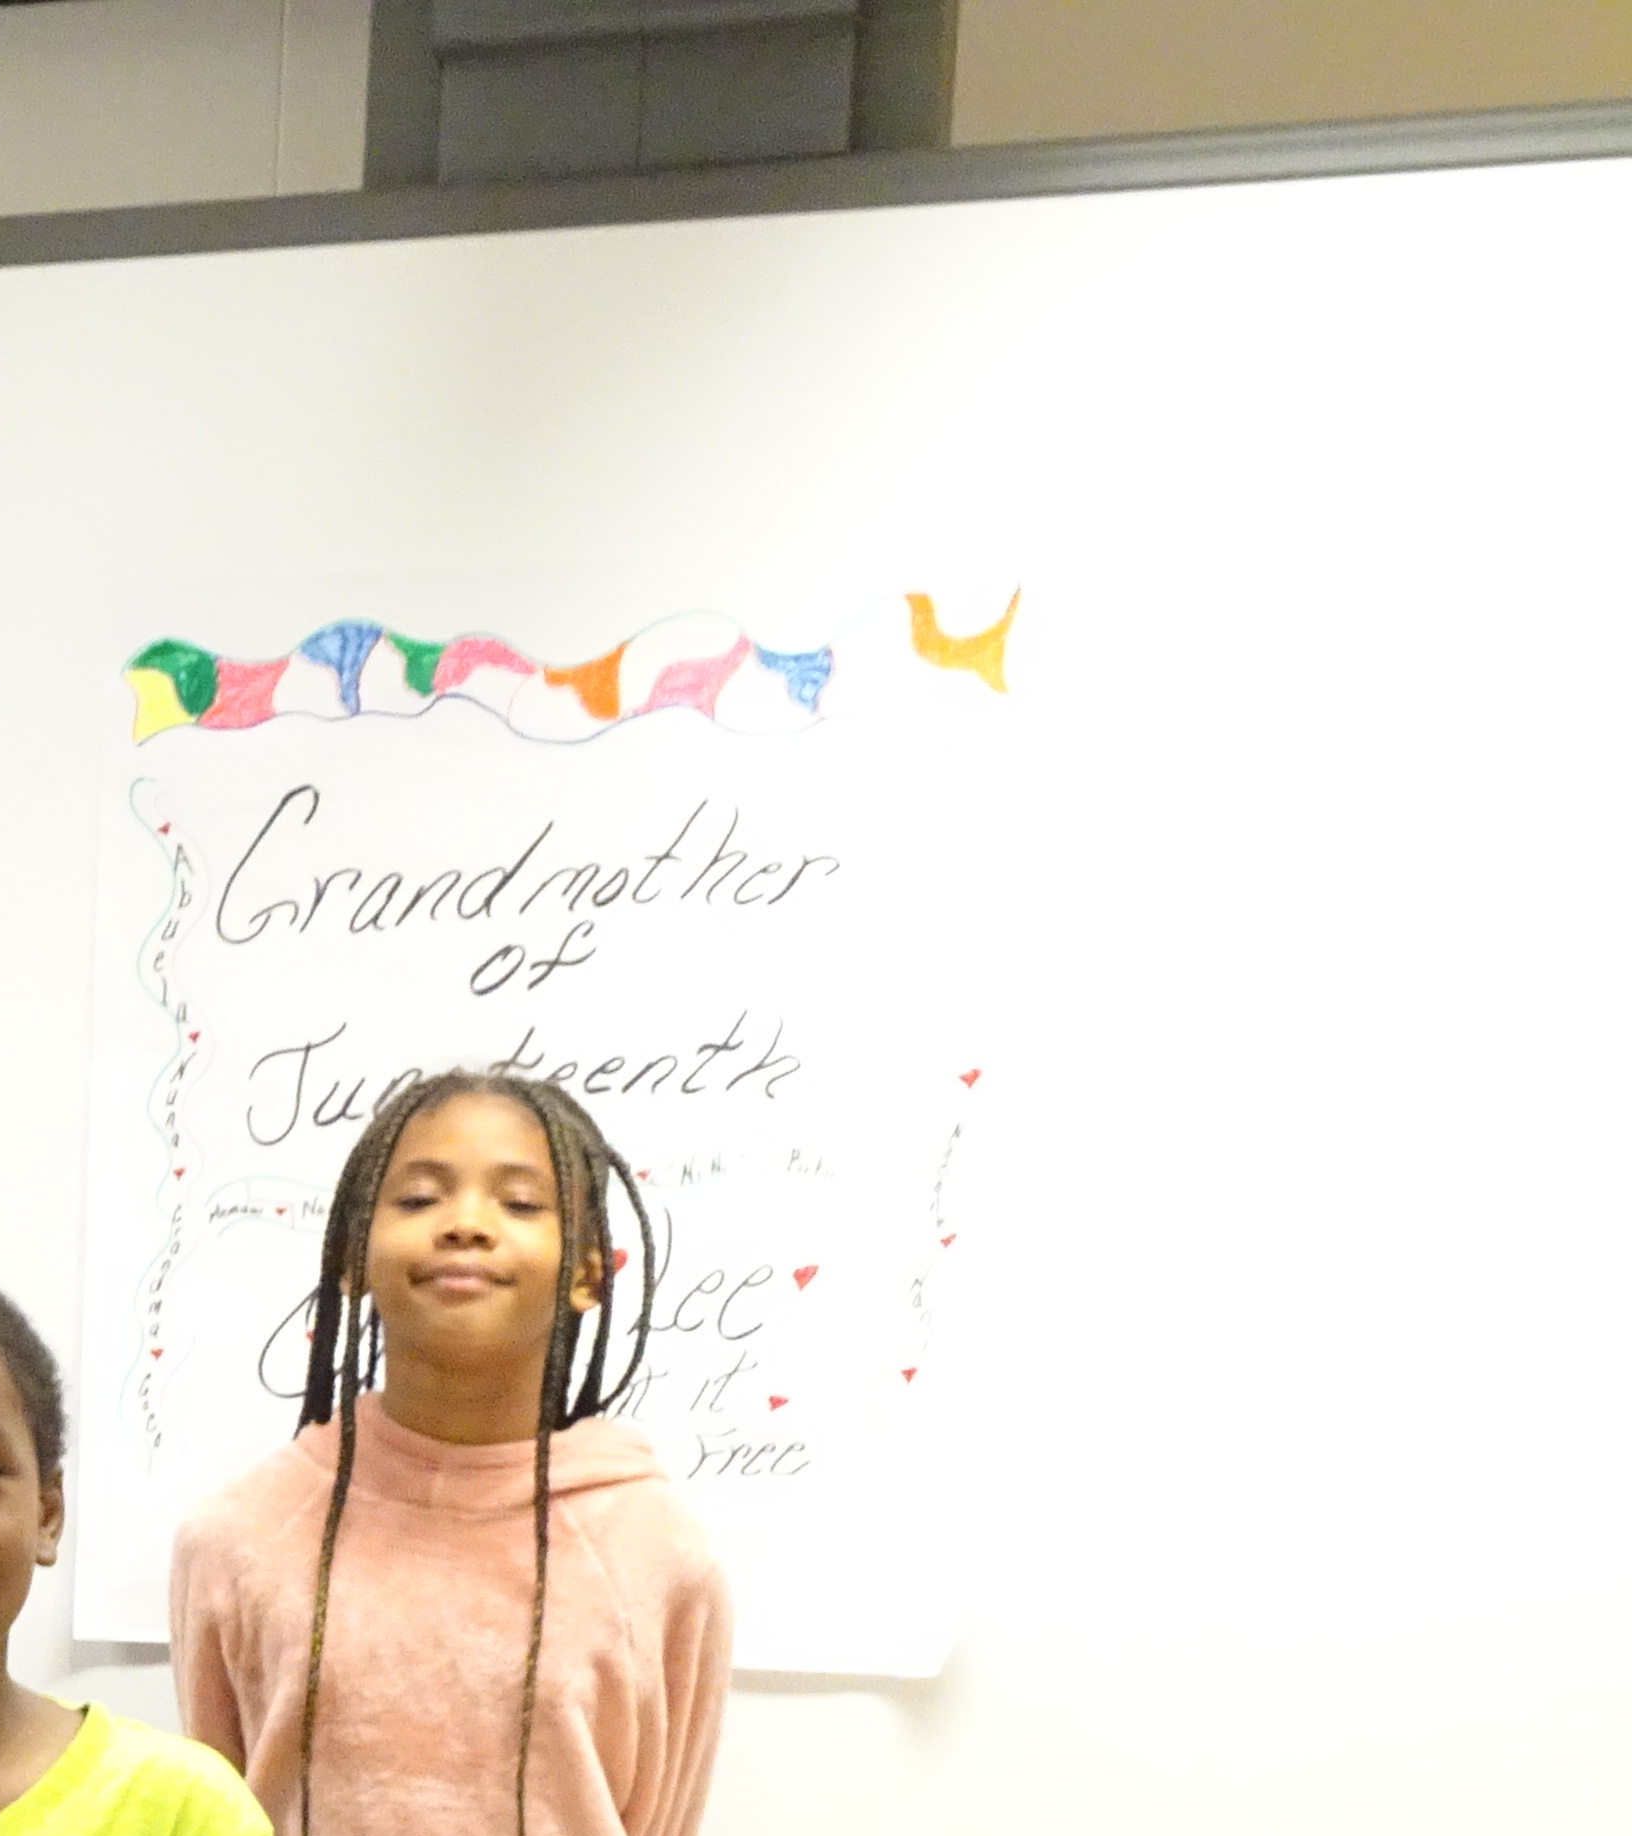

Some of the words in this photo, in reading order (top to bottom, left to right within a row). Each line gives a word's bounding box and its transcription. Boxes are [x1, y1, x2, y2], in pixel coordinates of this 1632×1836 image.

[216, 784, 840, 944] Grandmother
[471, 920, 596, 996] of
[687, 1427, 812, 1480] Free
